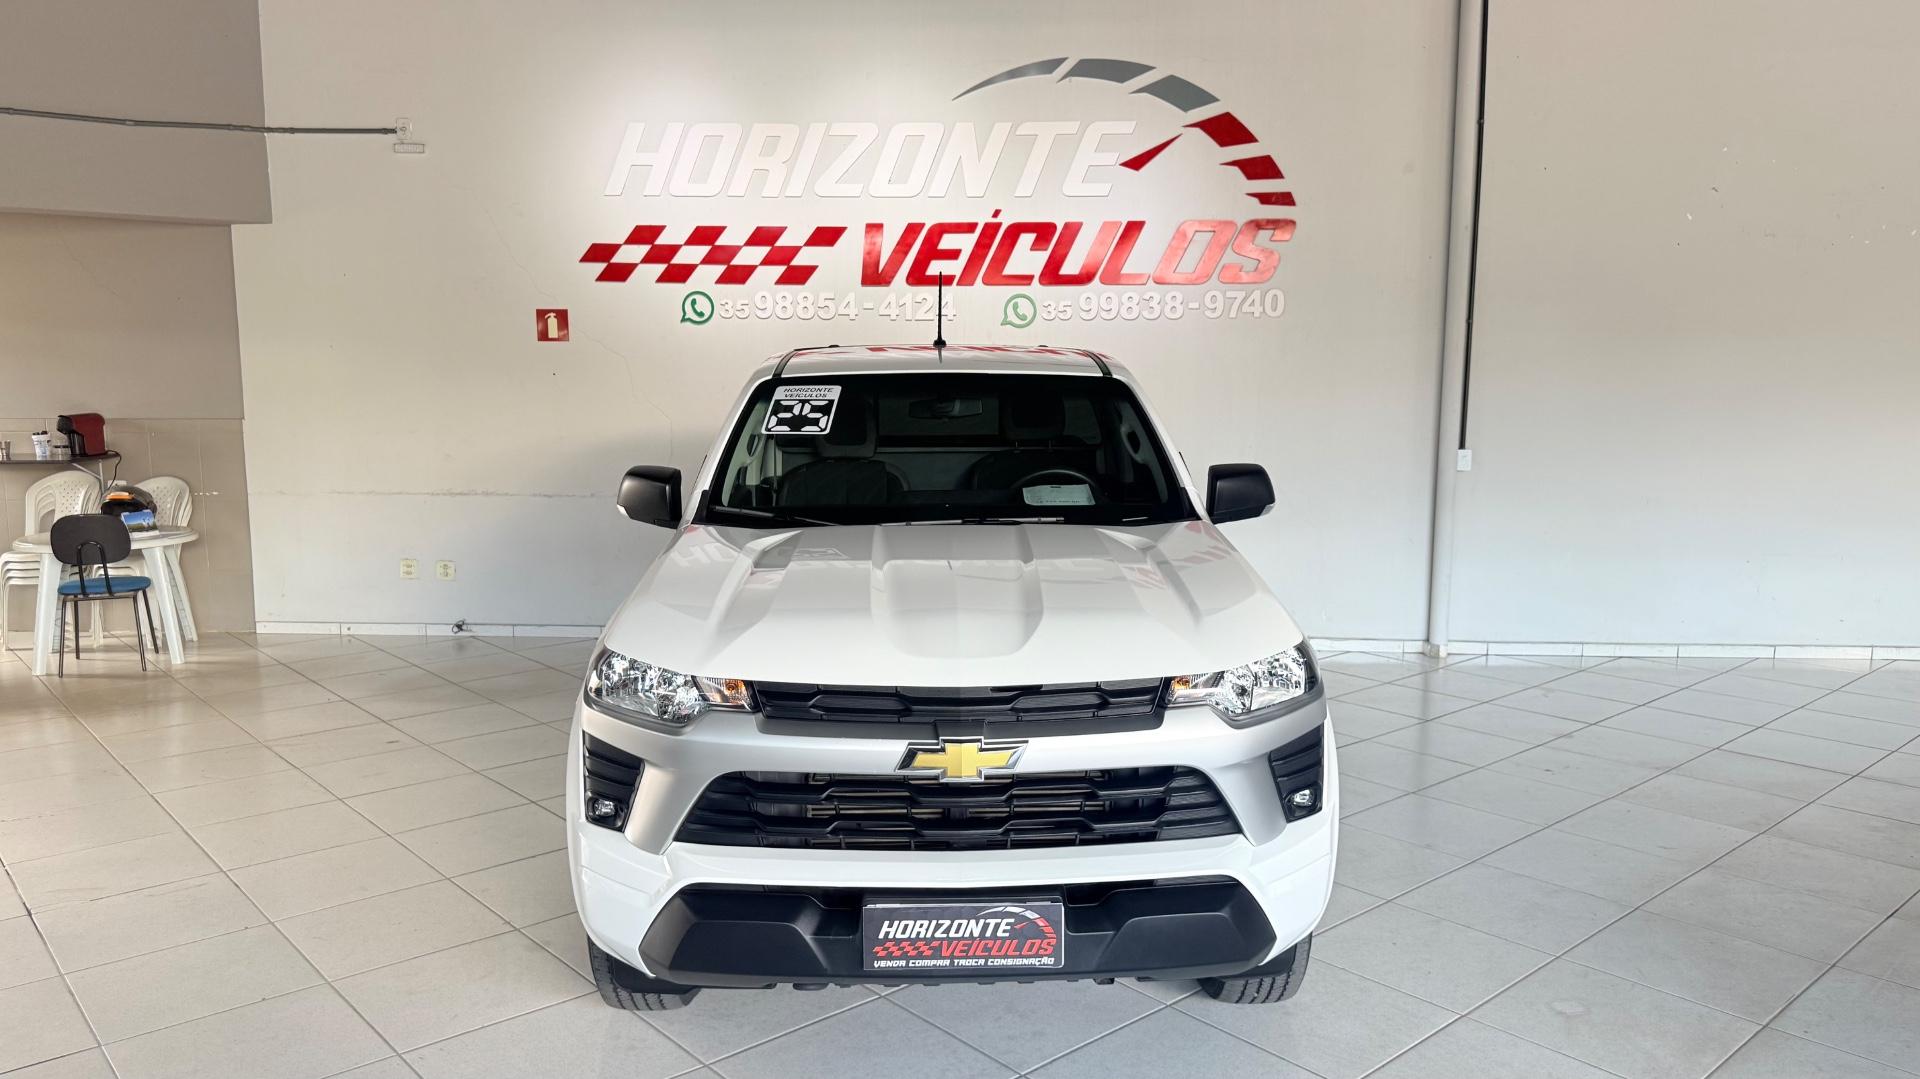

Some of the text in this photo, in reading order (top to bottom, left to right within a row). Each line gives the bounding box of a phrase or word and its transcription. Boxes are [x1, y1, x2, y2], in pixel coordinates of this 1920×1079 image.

[603, 121, 1138, 199] HORIZONTE
[861, 209, 1297, 287] VEÍCULOS
[719, 299, 750, 320] 35
[1040, 300, 1073, 321] 35
[878, 918, 1015, 939] HORIZONTE
[941, 937, 1057, 957] VEÍCULOS
[873, 957, 1055, 968] VENDA COMPRA TROCA CONSIGNAÇÃO
